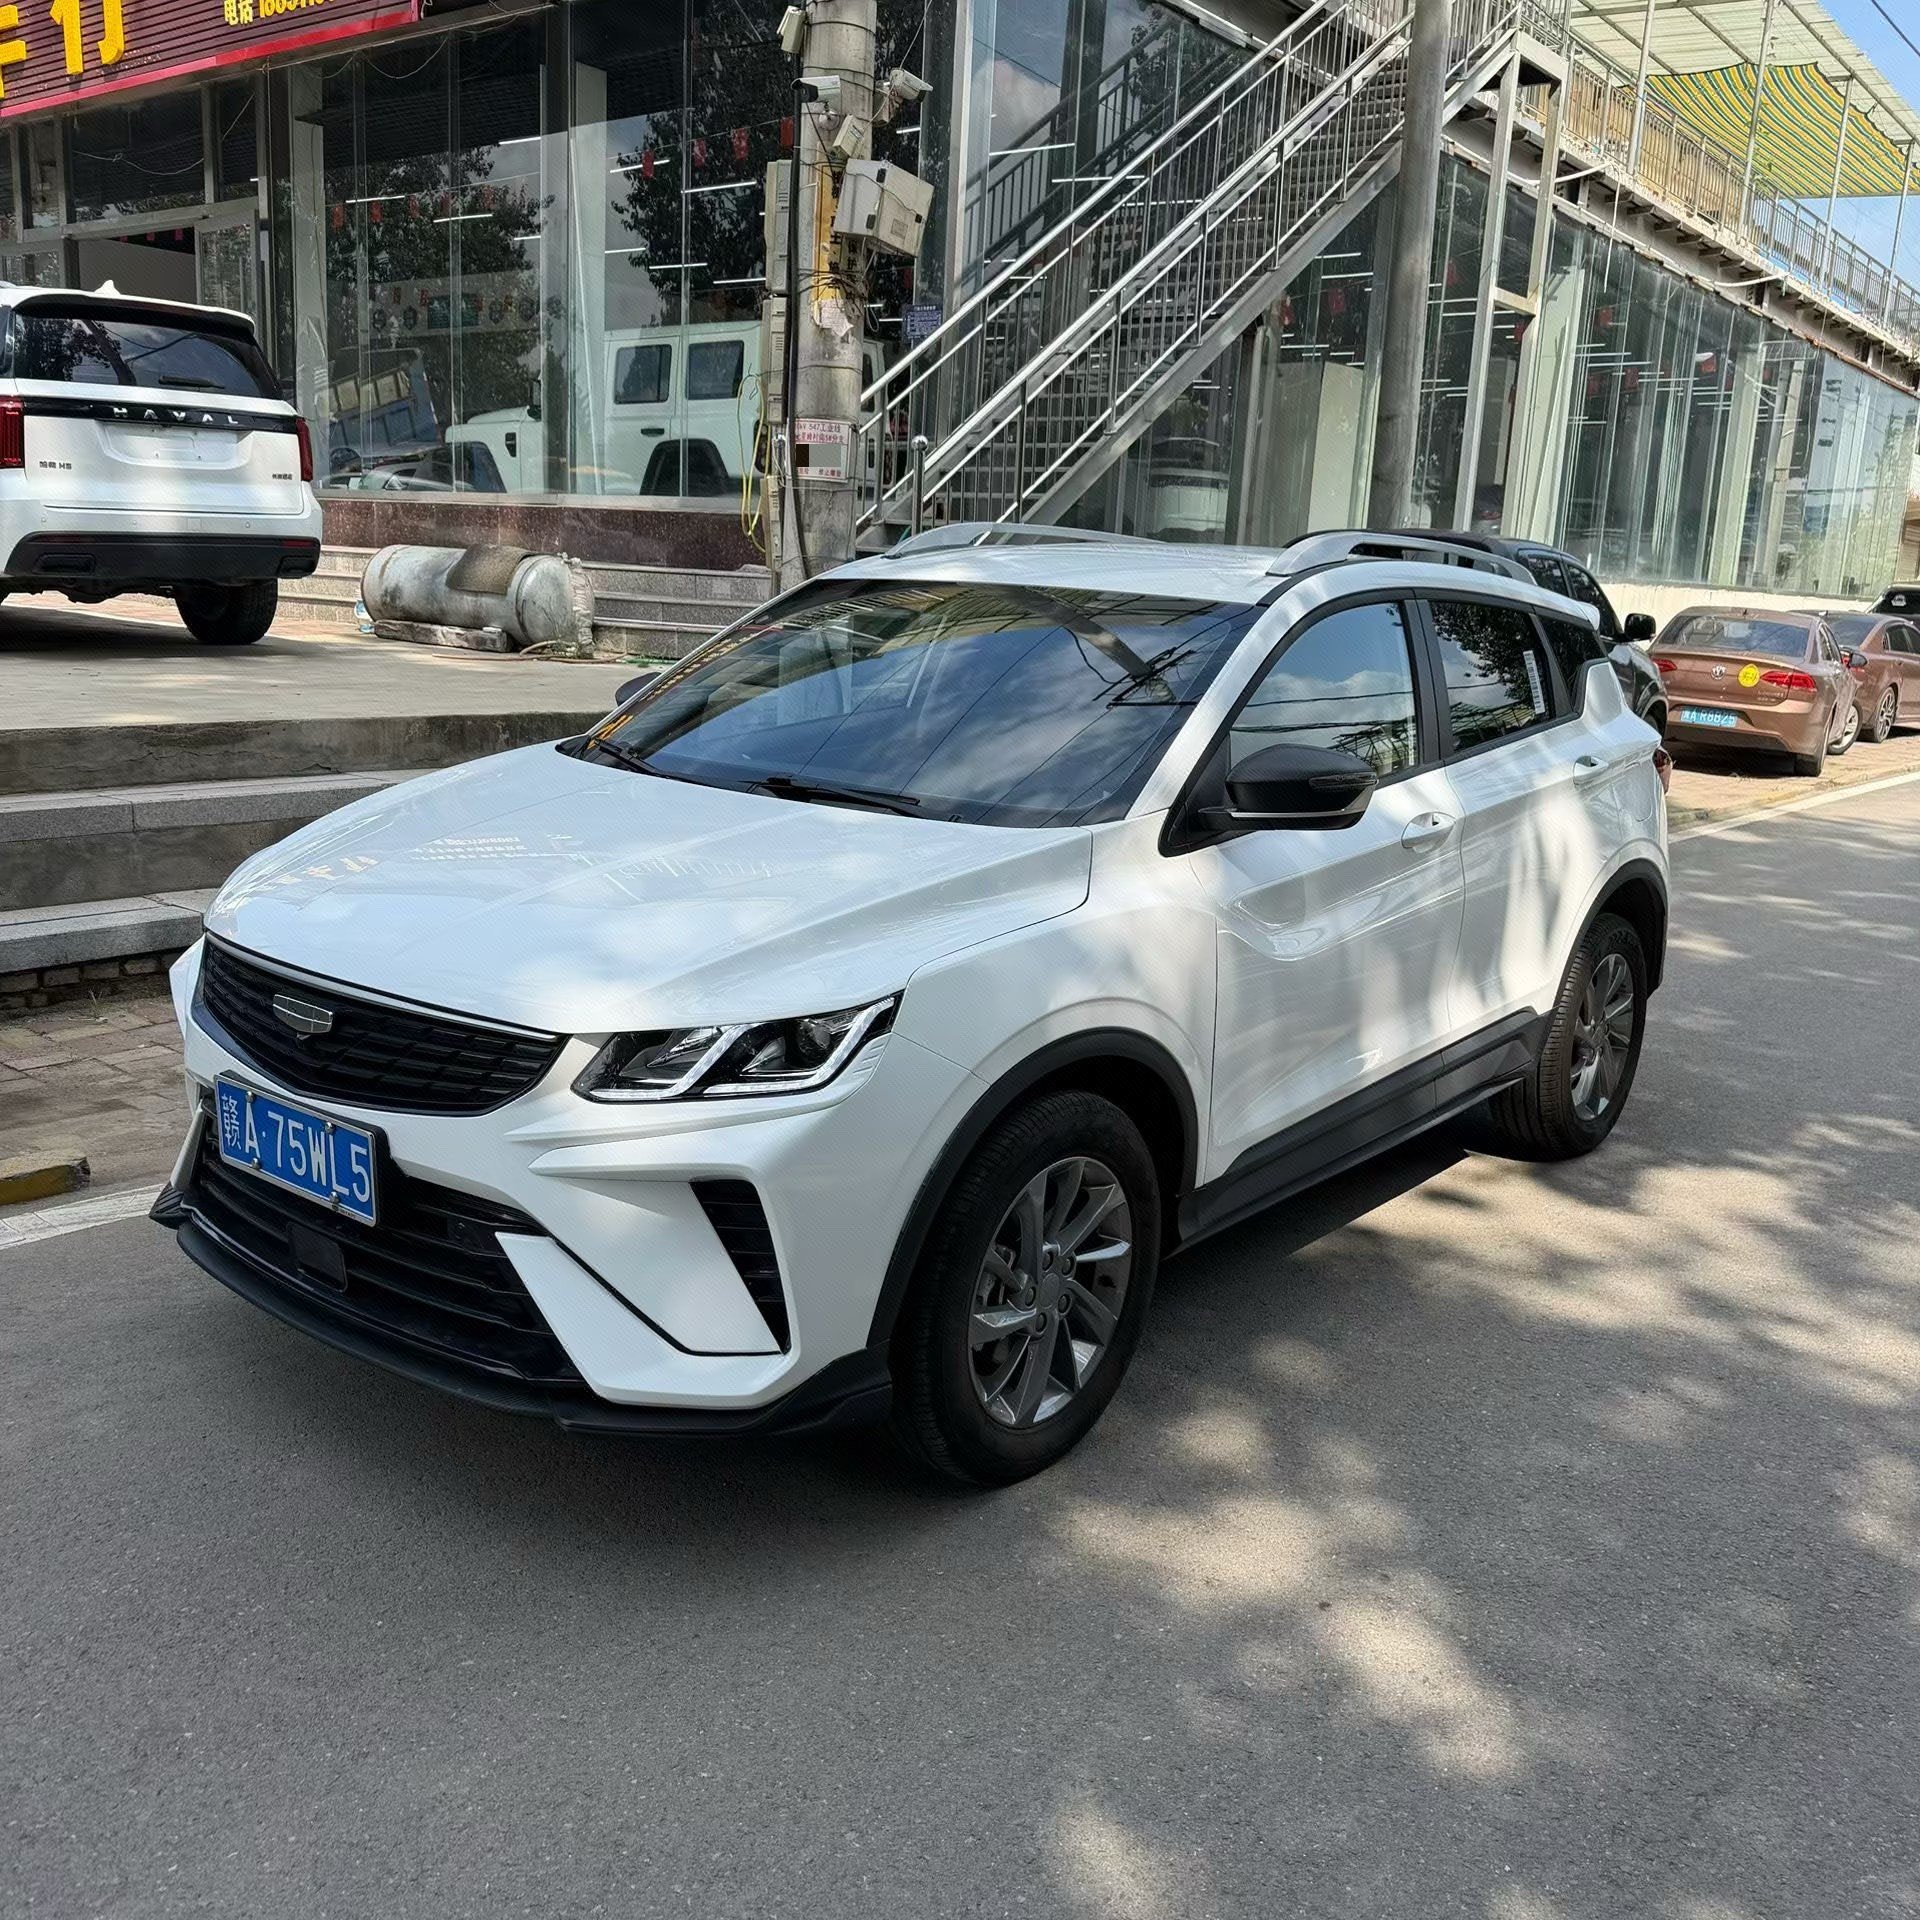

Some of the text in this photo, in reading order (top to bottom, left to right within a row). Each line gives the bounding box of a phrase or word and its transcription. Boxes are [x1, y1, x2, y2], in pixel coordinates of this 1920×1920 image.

[224, 0, 253, 26] 电话
[112, 406, 239, 424] HAVAL
[221, 1093, 371, 1203] 赣A·75WL5
